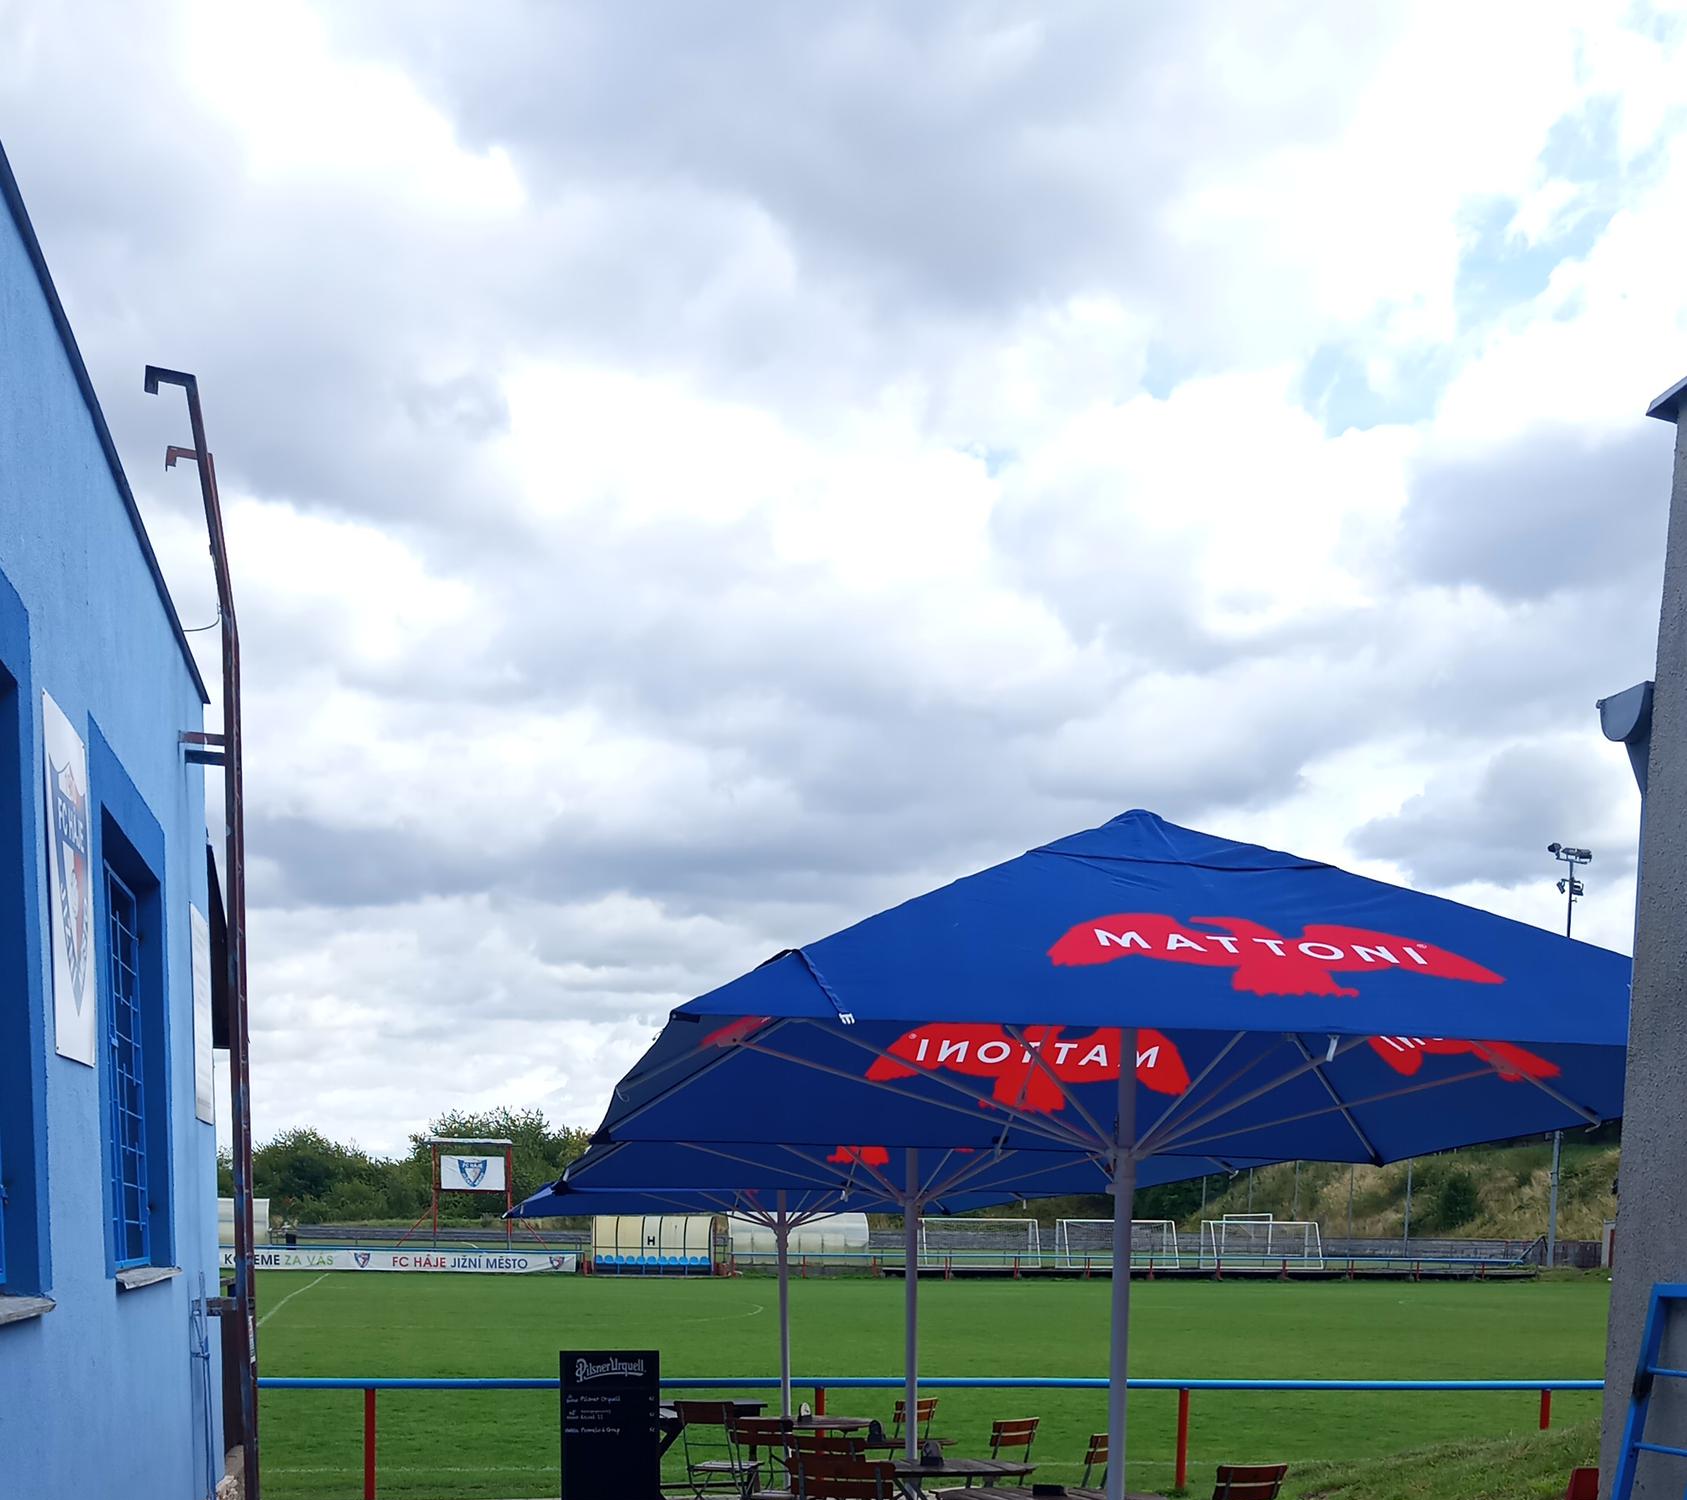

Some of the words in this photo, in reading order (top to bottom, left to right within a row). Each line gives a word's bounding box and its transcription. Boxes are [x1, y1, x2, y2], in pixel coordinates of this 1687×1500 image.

[1093, 927, 1428, 965] MATTONI
[647, 1236, 655, 1246] H
[285, 1254, 302, 1265] ZA
[306, 1251, 334, 1266] VÁS
[392, 1256, 409, 1267] FC
[413, 1253, 446, 1268] HÁJE
[450, 1254, 482, 1269] JIŽNÍ
[486, 1255, 528, 1270] MĚSTO
[575, 1357, 611, 1383] Pilsner
[609, 1356, 645, 1377] Urquell
